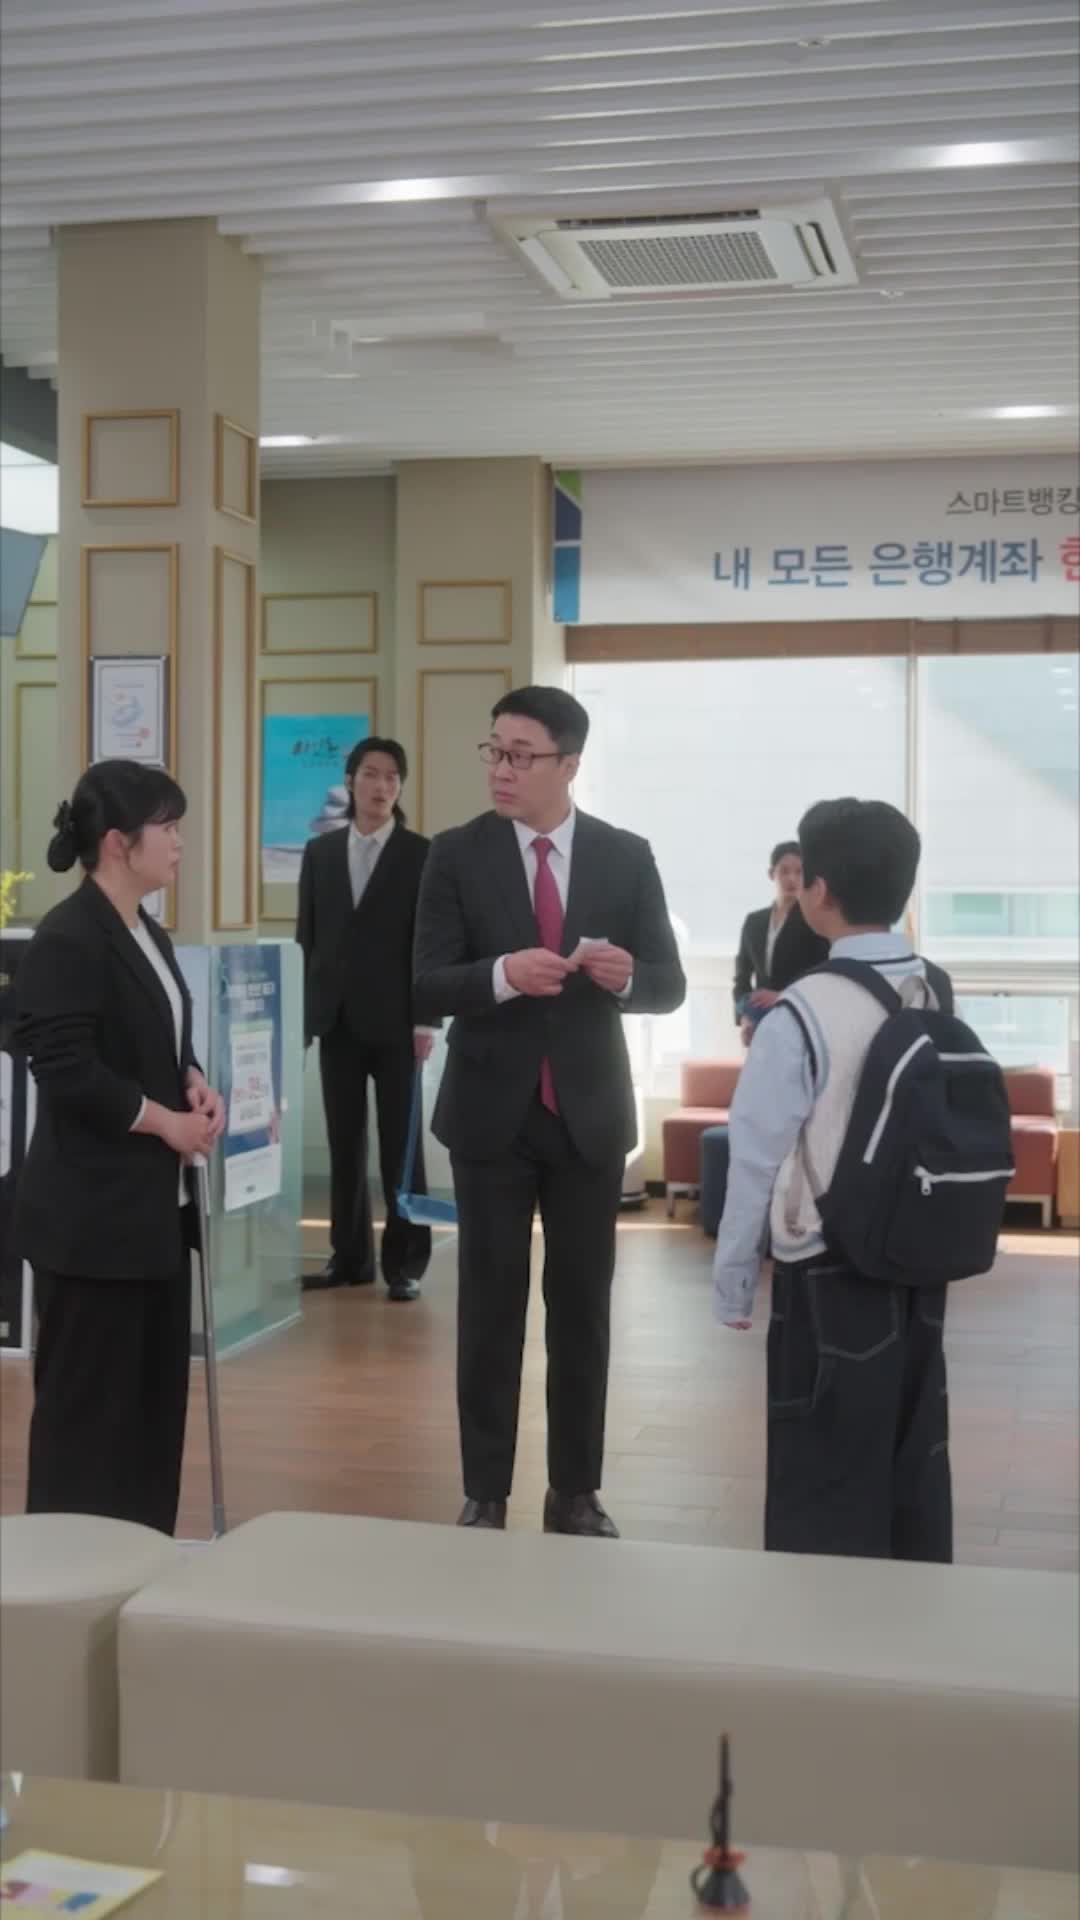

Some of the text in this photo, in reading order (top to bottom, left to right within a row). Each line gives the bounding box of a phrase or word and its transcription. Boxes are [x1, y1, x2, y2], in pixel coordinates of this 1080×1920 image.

[945, 487, 1080, 517] 스마트뱅킹
[713, 547, 750, 590] 내
[768, 545, 853, 588] 모든
[868, 537, 1044, 586] 은행계좌
